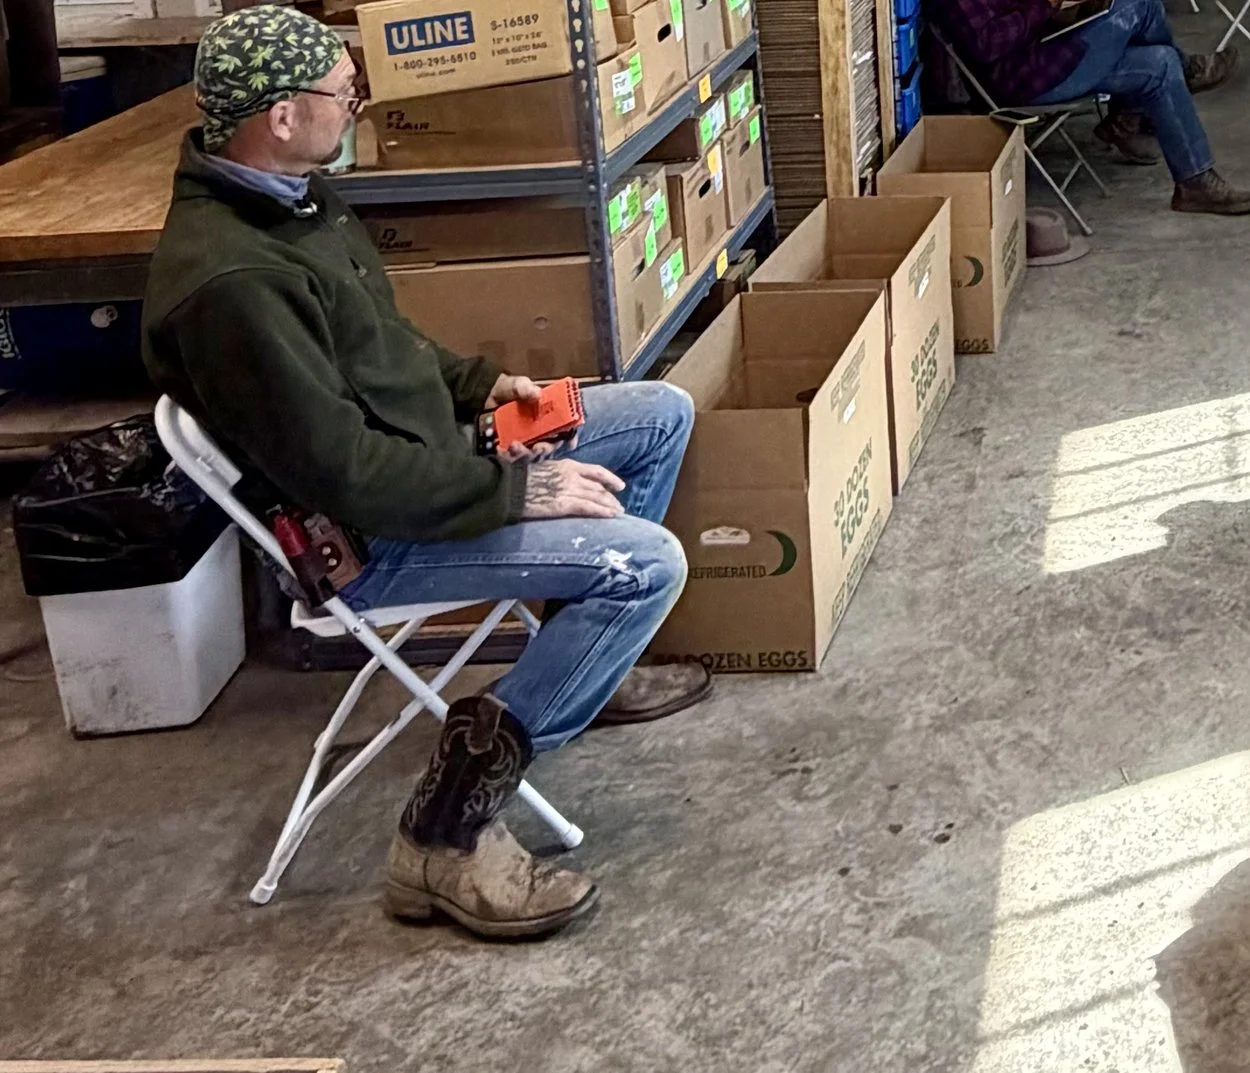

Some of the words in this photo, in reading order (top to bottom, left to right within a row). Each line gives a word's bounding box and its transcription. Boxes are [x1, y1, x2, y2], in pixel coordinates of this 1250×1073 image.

[391, 16, 470, 50] ULINE
[490, 13, 539, 31] S-16589
[916, 348, 937, 412] EGGS
[834, 490, 844, 527] 30
[846, 436, 872, 504] DOZEN
[841, 476, 869, 560] EGGS
[758, 650, 808, 668] EGGS
